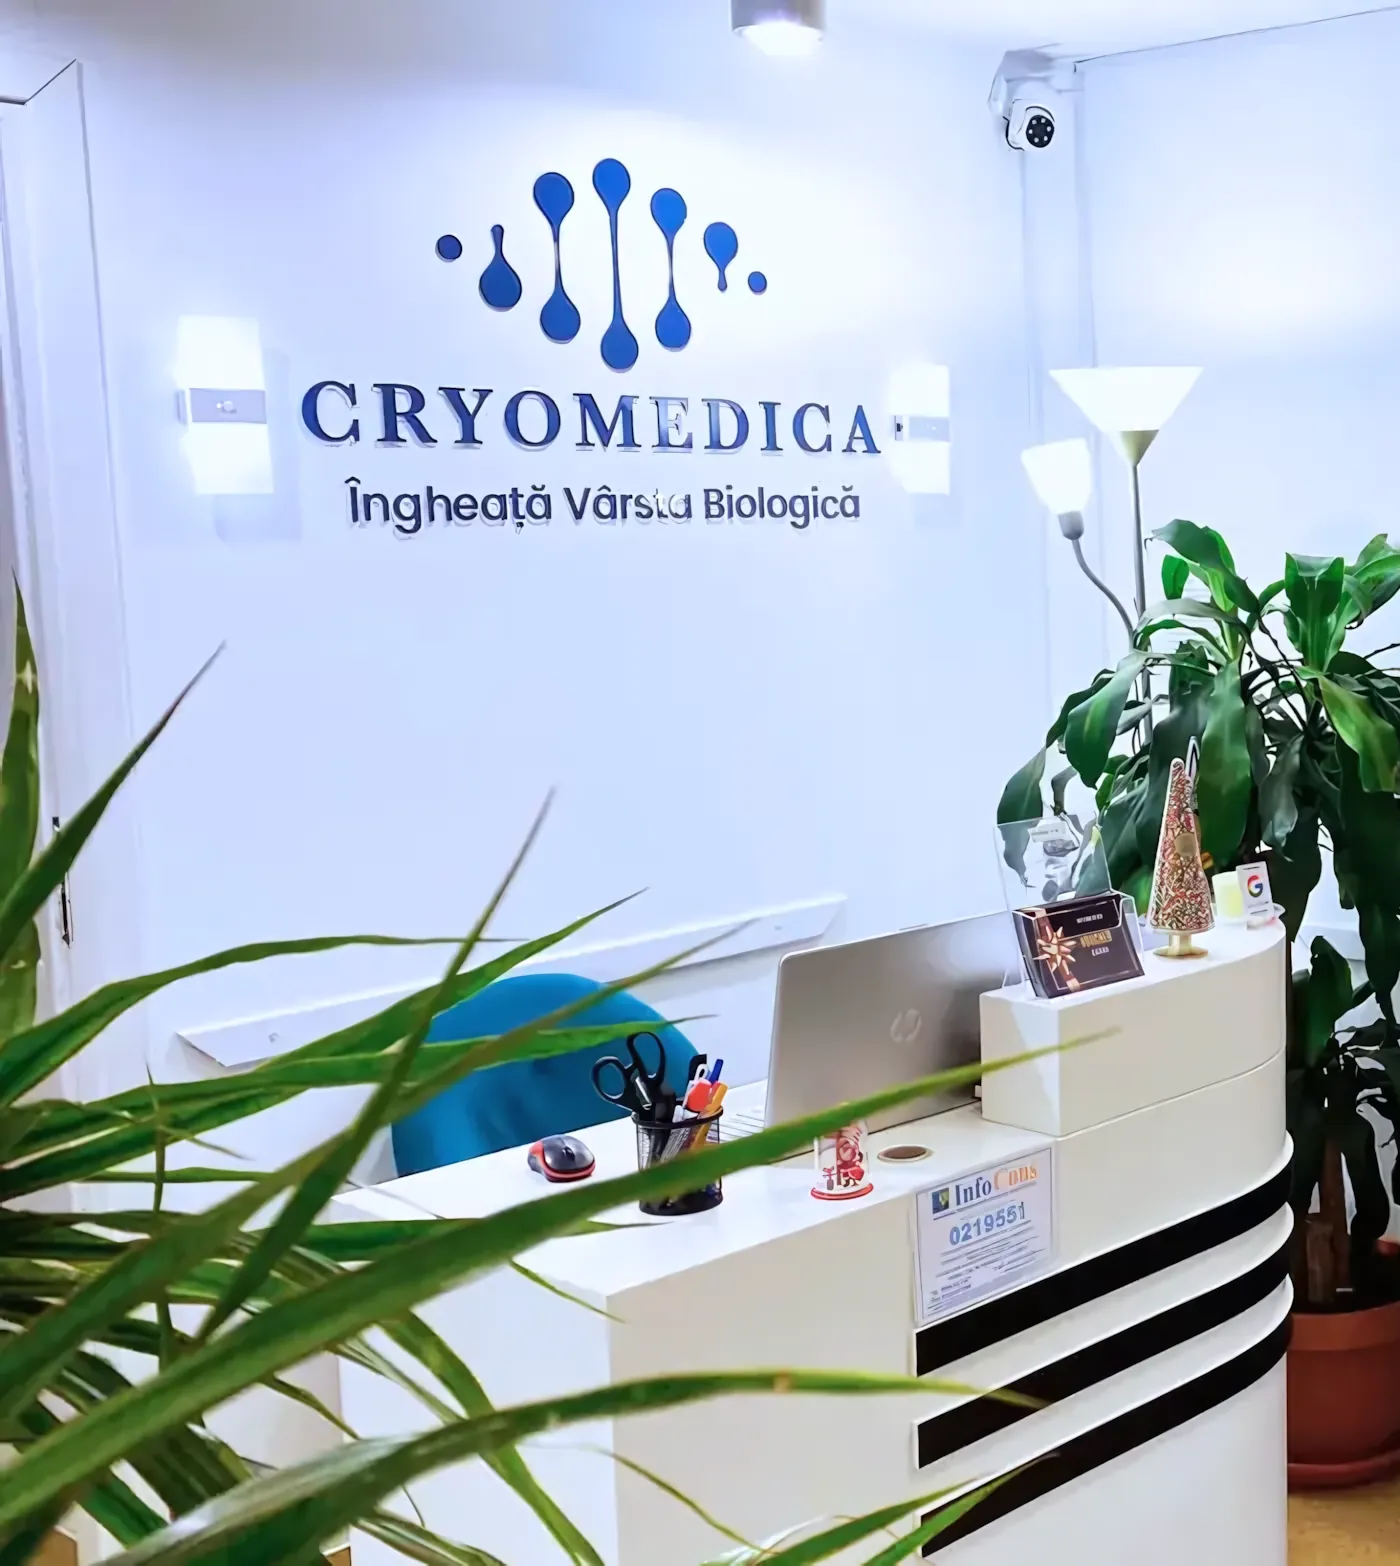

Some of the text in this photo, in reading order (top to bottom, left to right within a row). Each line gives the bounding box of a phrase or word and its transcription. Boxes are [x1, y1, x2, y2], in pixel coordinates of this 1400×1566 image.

[300, 380, 882, 455] CRYOMEDICA
[344, 476, 861, 535] Îngheață Vârsta Biologică
[949, 1201, 1025, 1246] 0219551
